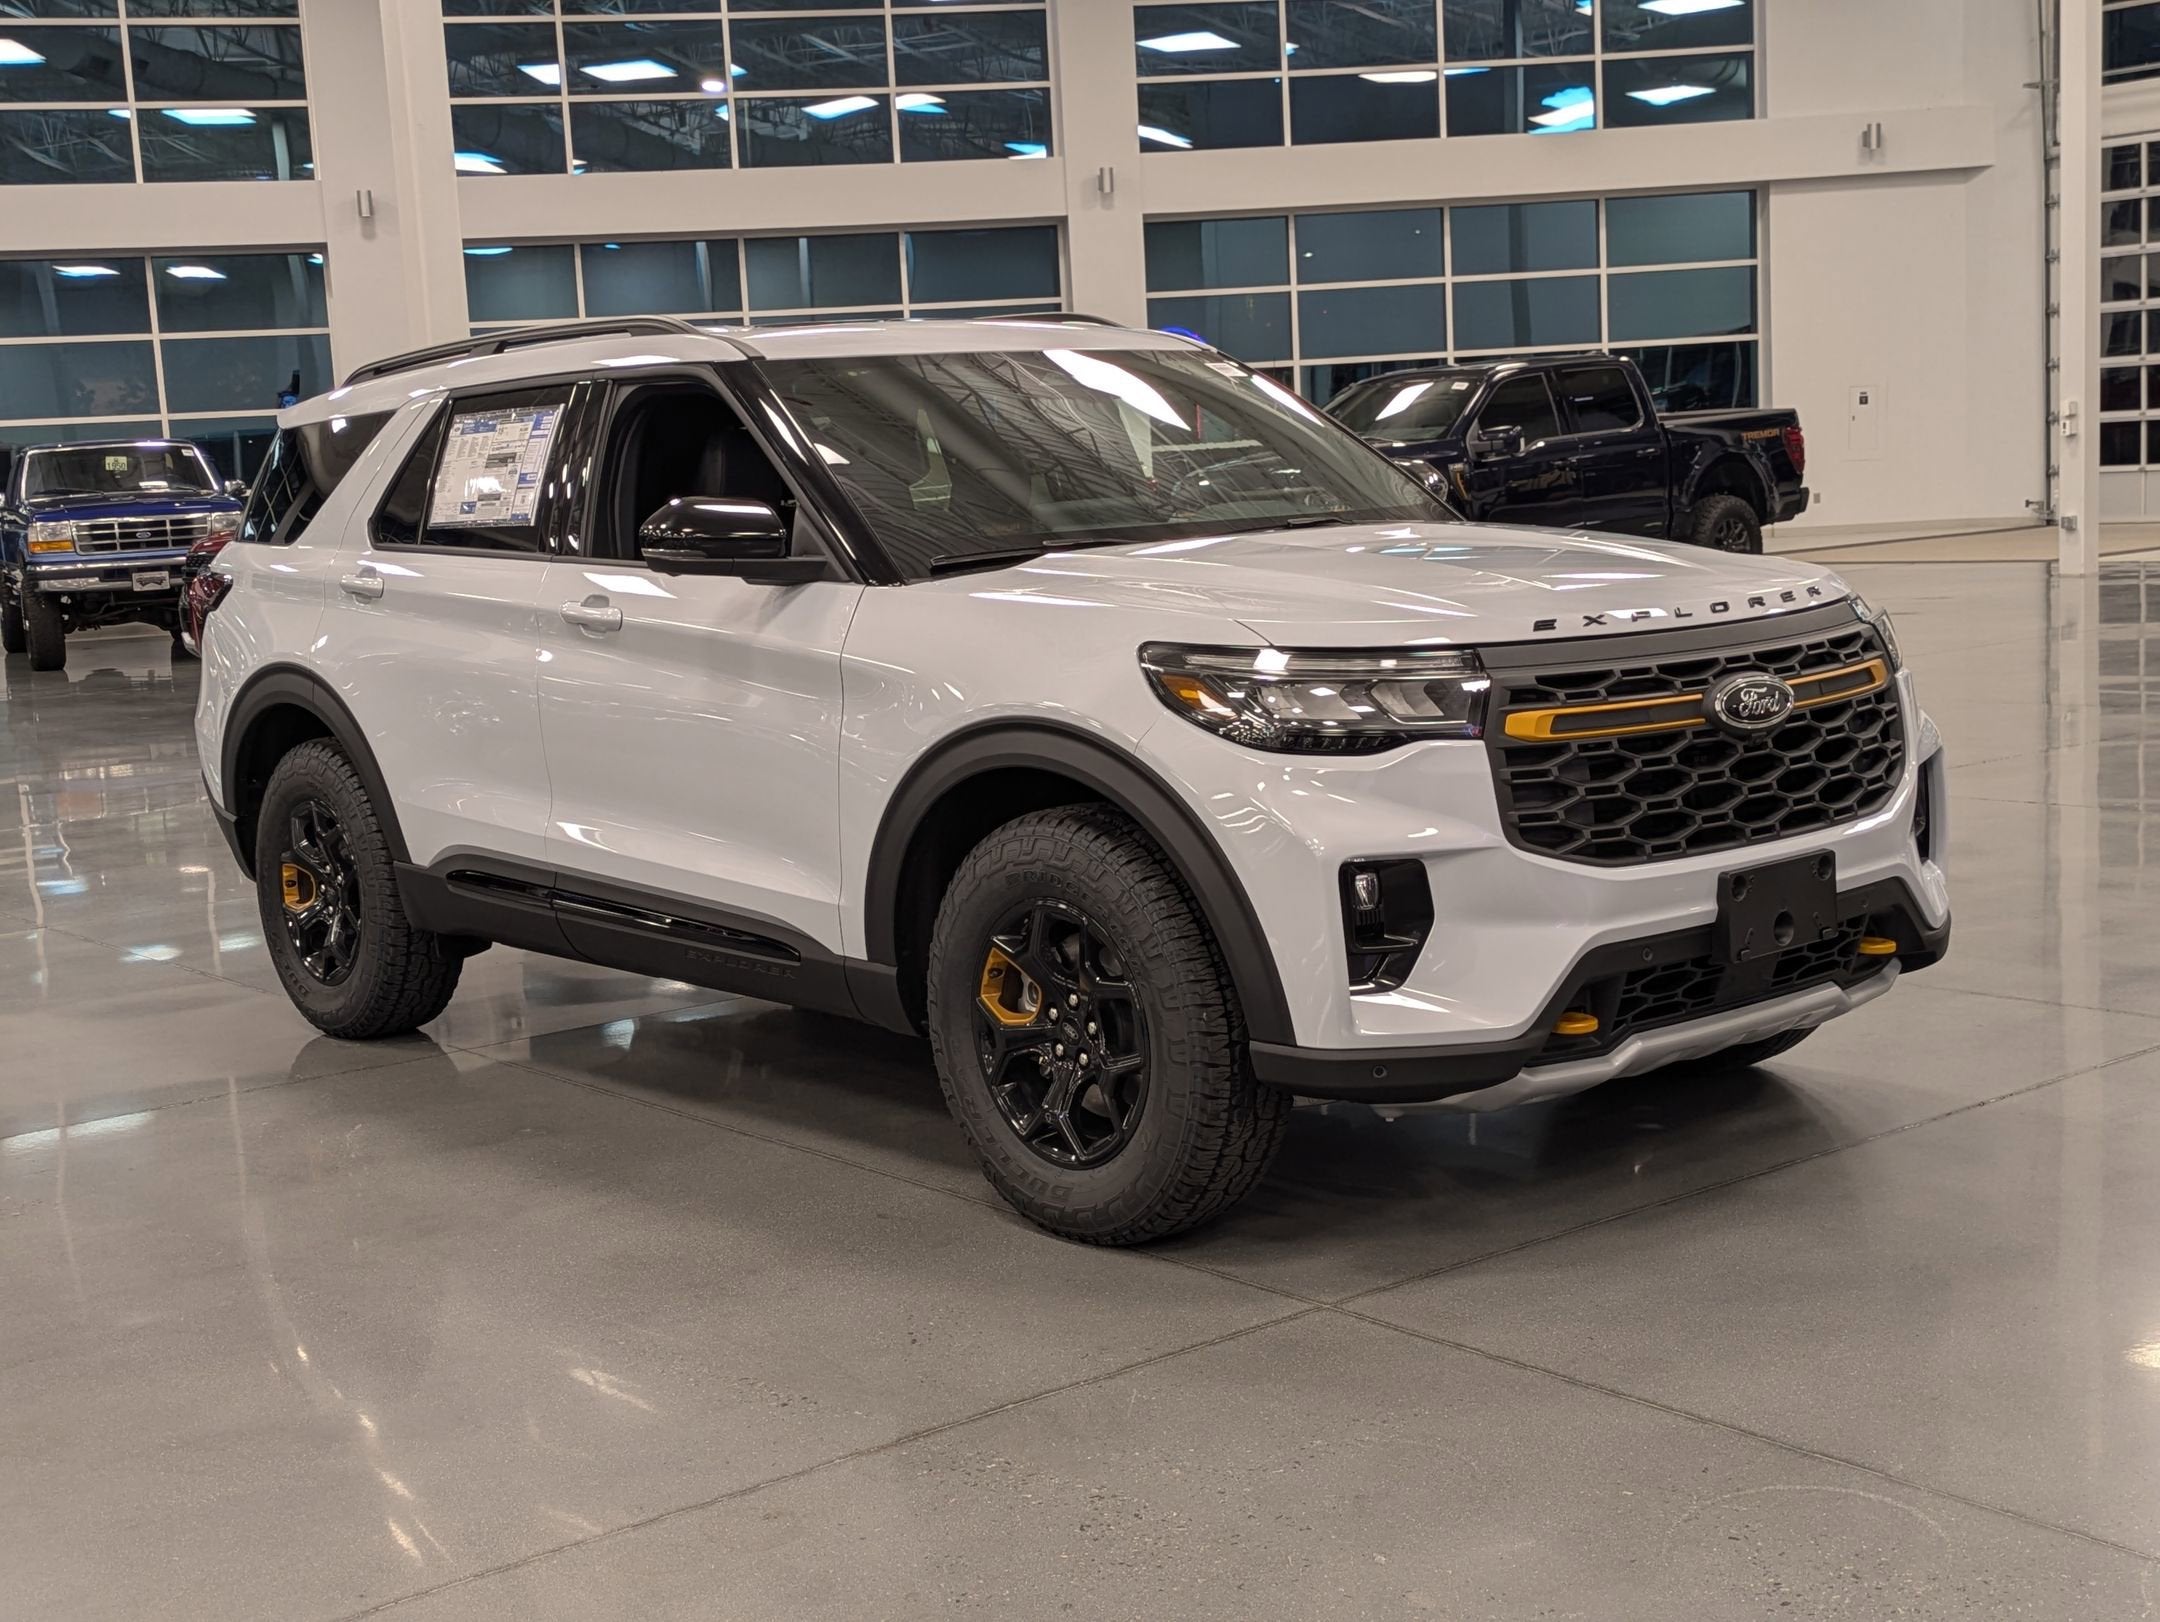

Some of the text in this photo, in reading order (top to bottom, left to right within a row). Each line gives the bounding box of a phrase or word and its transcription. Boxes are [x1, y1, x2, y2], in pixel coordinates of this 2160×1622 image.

[1741, 428, 1780, 440] TREMOR
[1532, 585, 1823, 632] EXPLORER
[1738, 686, 1781, 717] Ford
